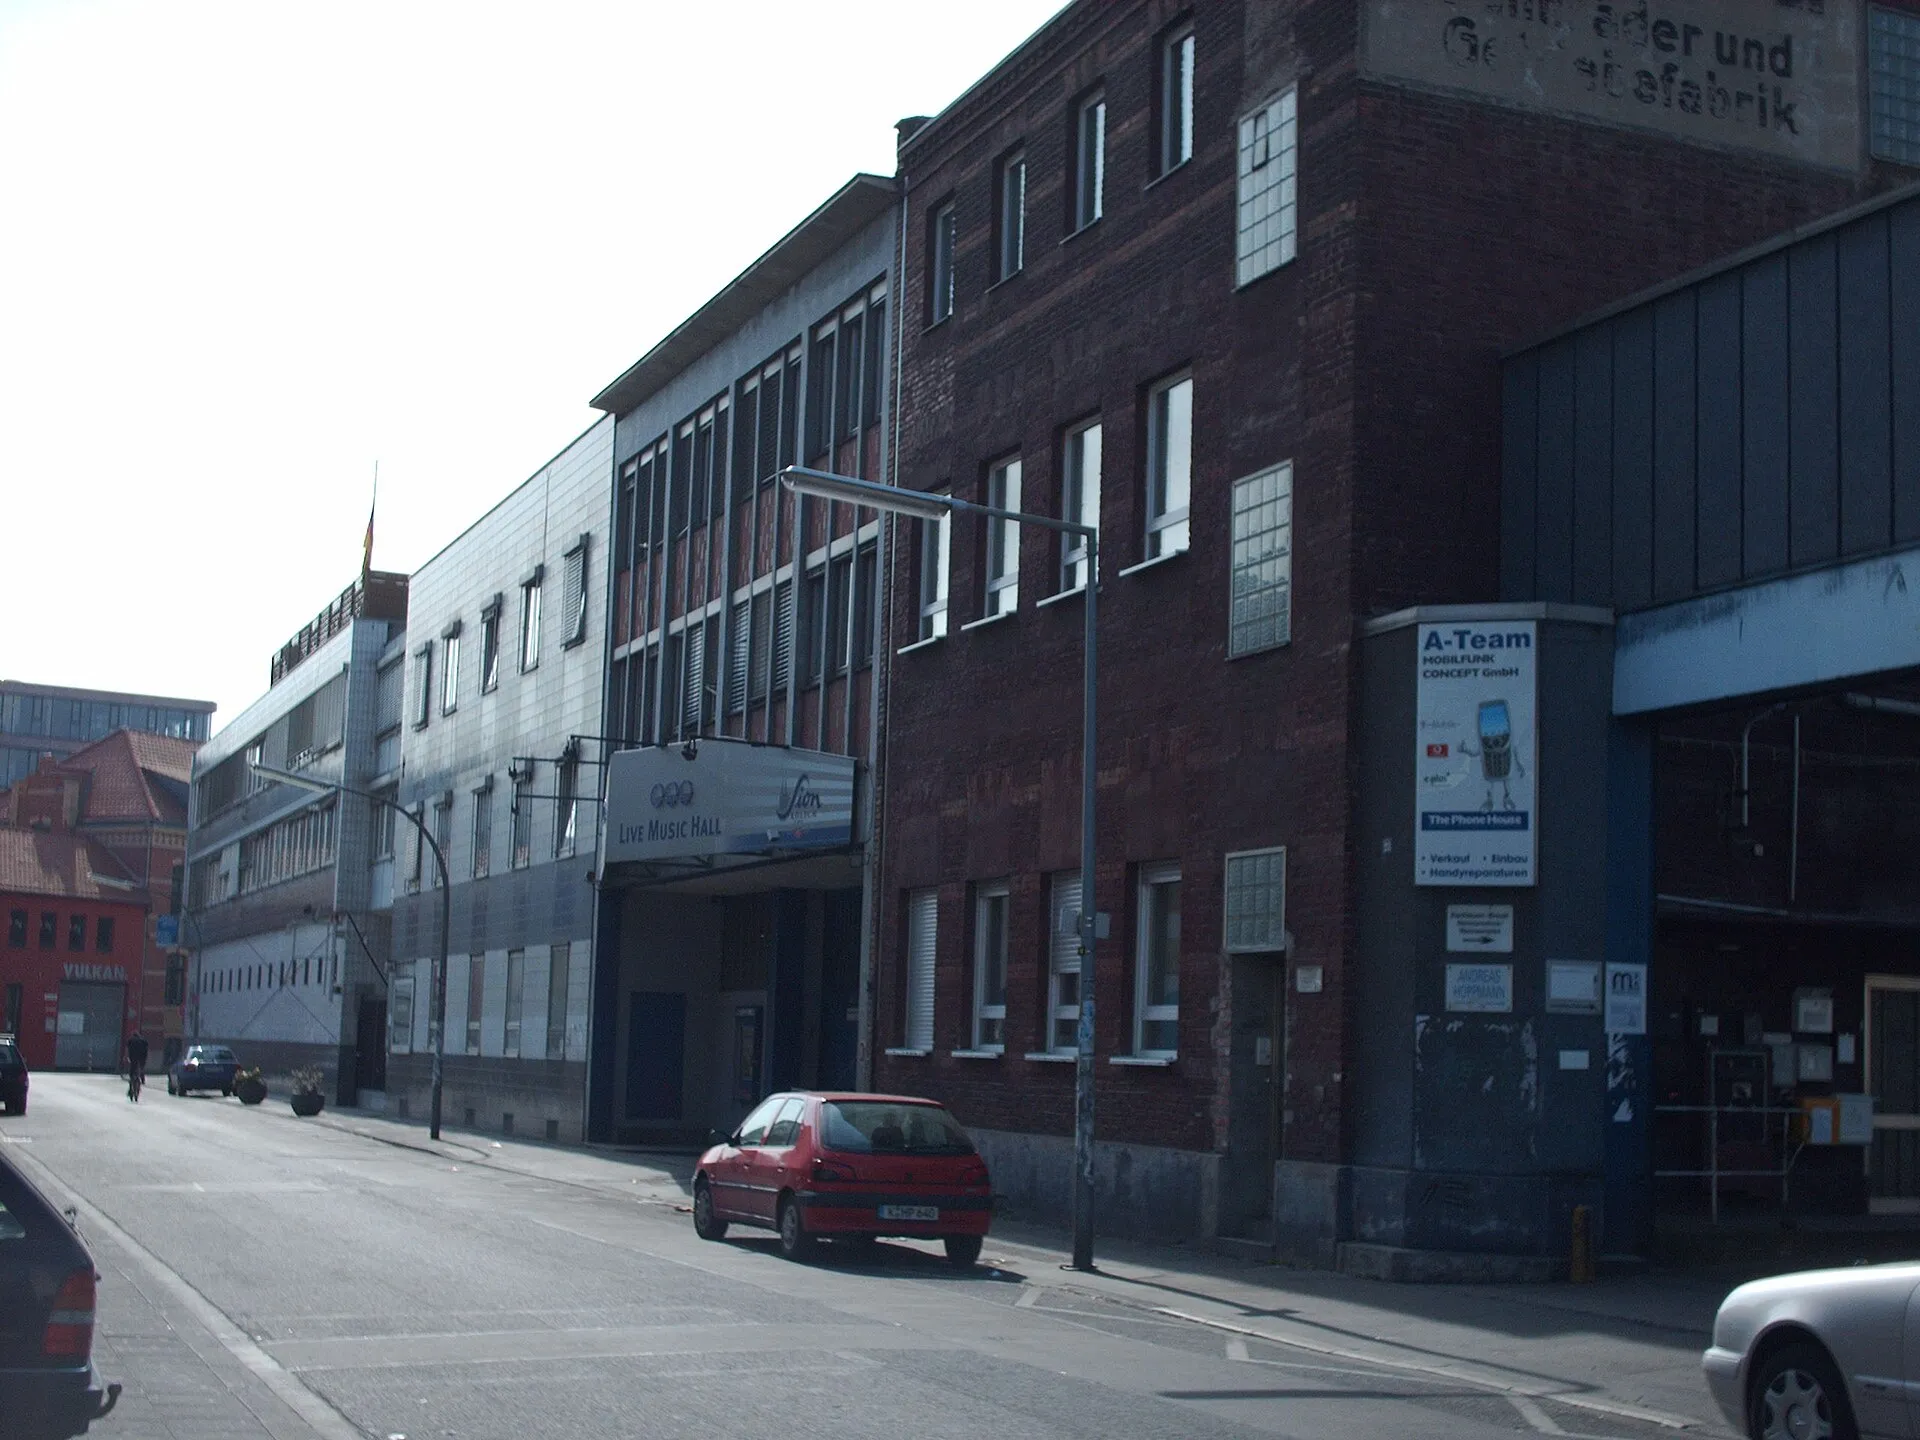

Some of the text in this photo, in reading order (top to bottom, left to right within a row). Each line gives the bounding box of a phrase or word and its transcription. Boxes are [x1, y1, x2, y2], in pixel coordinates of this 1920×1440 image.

[1715, 29, 1794, 78] und
[1424, 629, 1531, 651] A-Team
[1423, 654, 1495, 665] MOBILFUNK
[1423, 667, 1519, 678] CONCEPT GmbH
[1452, 814, 1487, 825] Phone
[1430, 853, 1528, 863] Verkauf Einbau
[1429, 867, 1528, 879] Handyreparaturen
[63, 962, 126, 980] VULKAN
